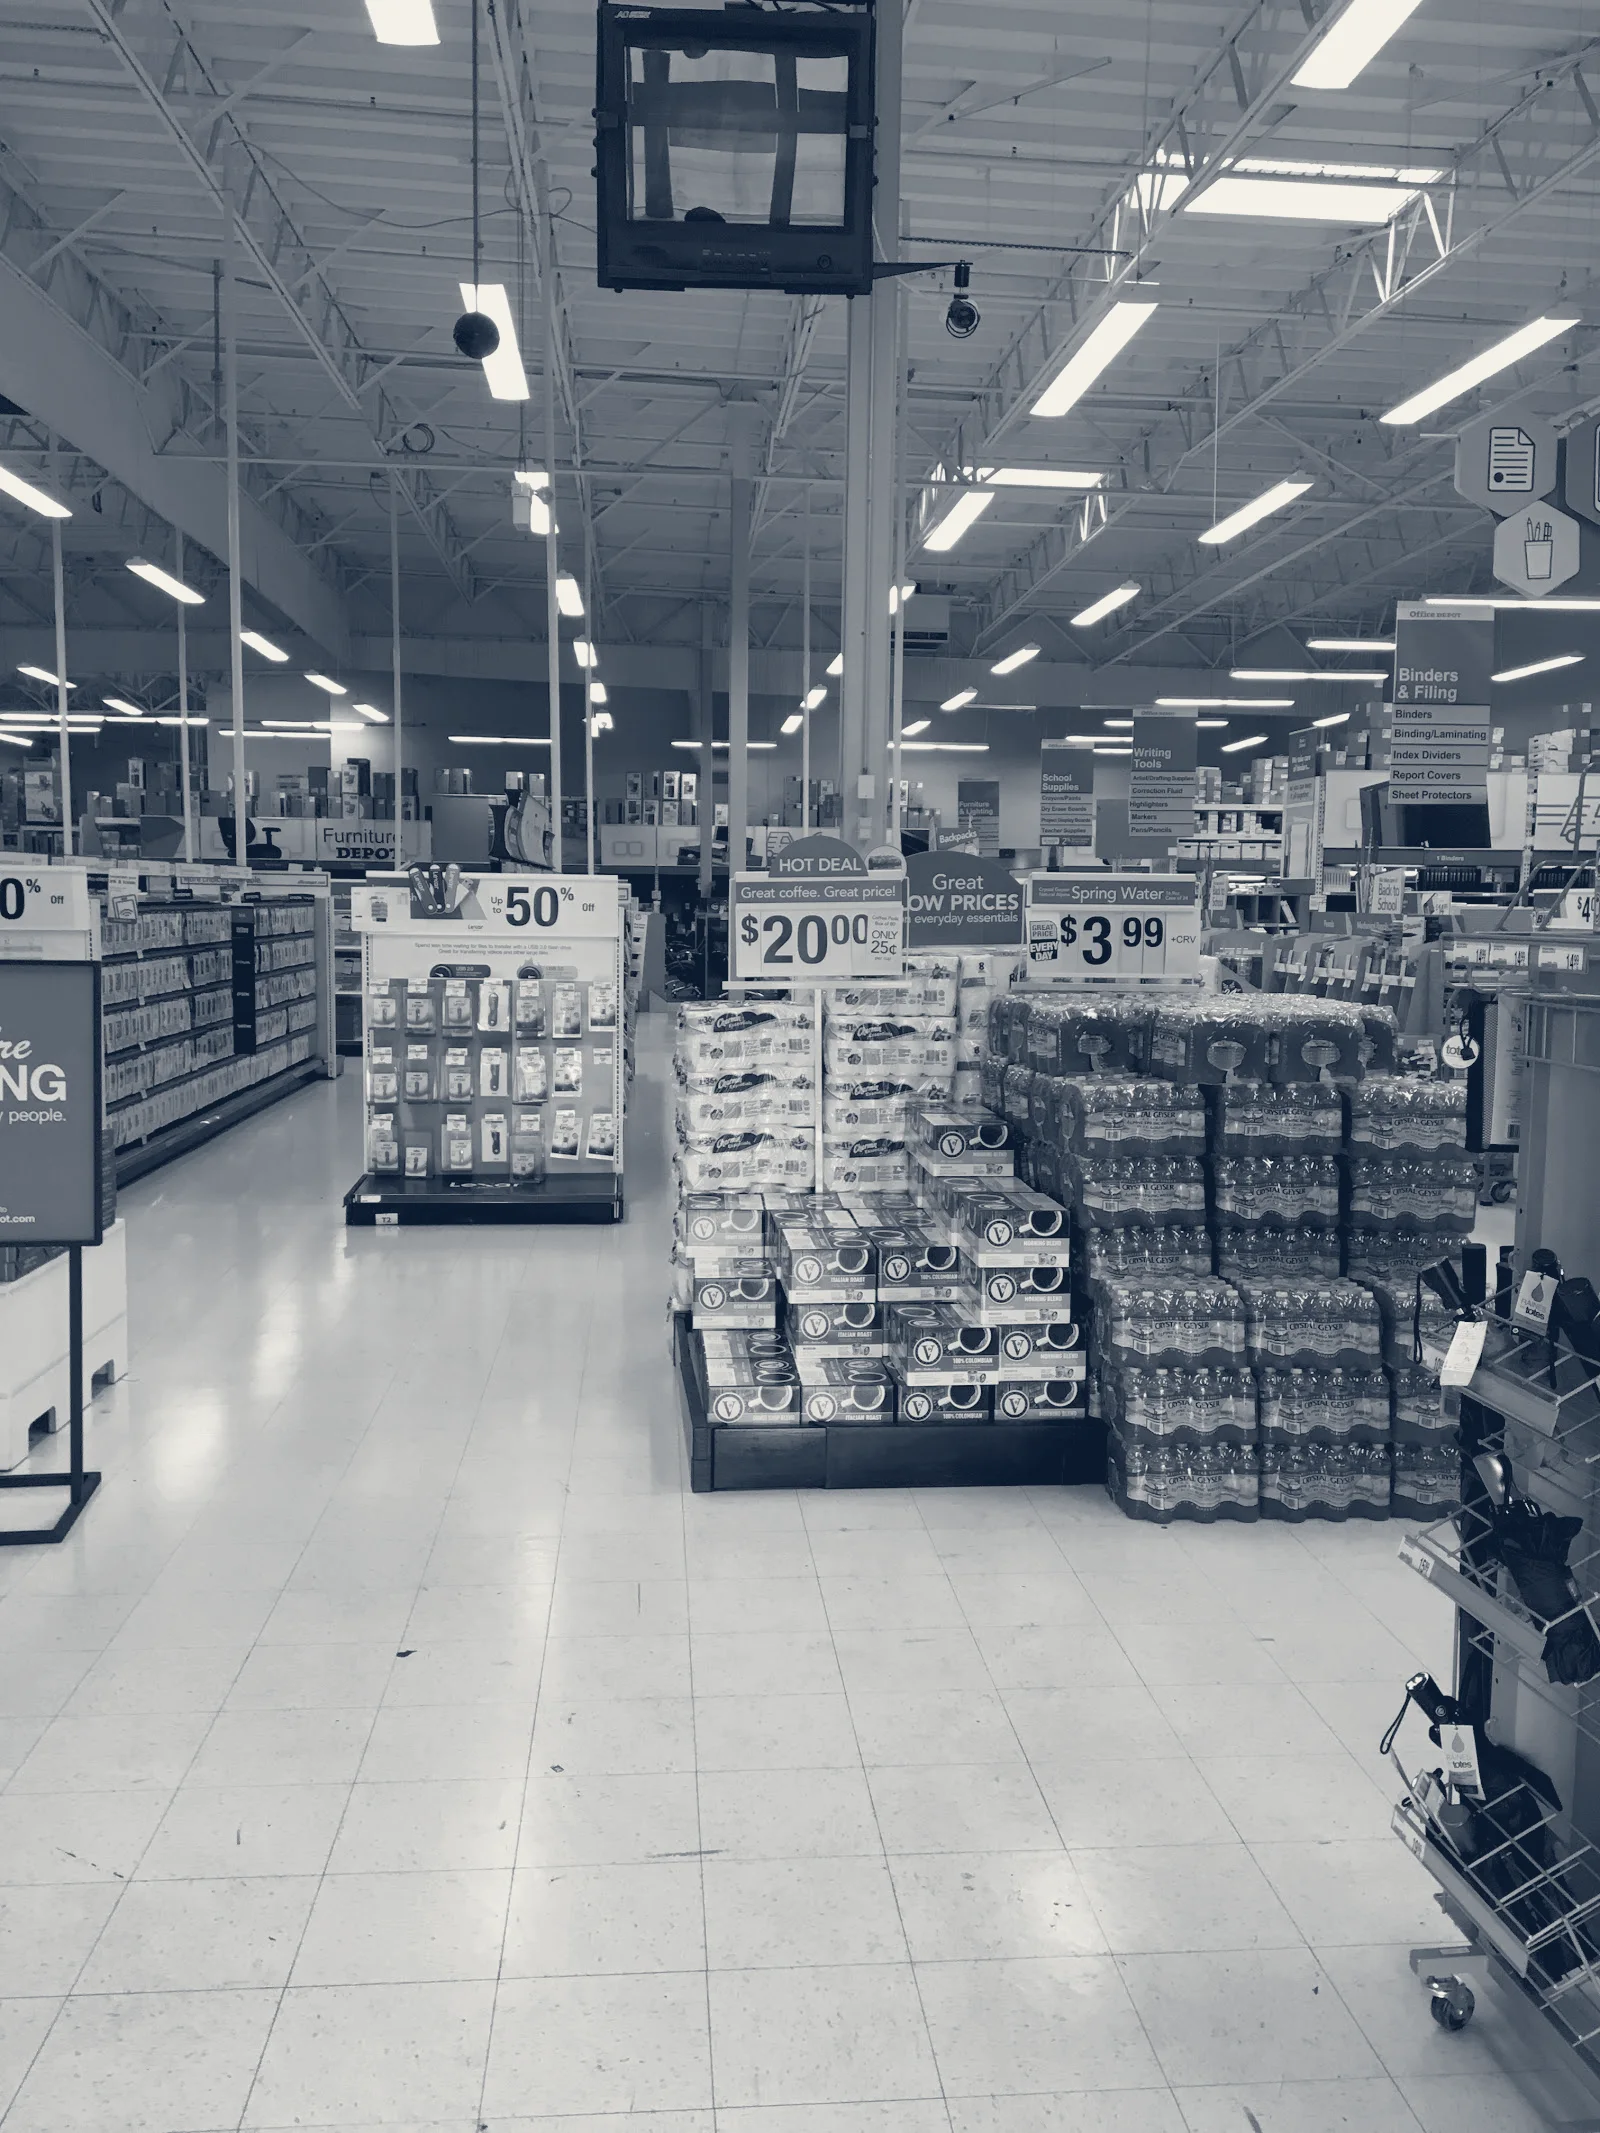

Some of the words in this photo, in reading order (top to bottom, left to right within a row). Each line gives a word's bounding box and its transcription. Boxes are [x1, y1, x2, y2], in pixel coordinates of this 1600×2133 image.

[1400, 668, 1458, 682] Binders
[1398, 685, 1409, 699] &
[1414, 685, 1457, 702] Filing
[1396, 710, 1432, 719] Binders
[1394, 730, 1487, 741] Binding/Laminating
[1134, 748, 1171, 759] Writing
[1394, 751, 1419, 759] Index
[1422, 751, 1461, 760] Dividers
[1134, 759, 1162, 768] Tools
[1042, 774, 1072, 782] School
[1392, 771, 1424, 781] Report
[1427, 772, 1461, 780] Covers
[1042, 783, 1079, 792] Supplies
[1392, 790, 1419, 799] Sheet
[1422, 790, 1472, 800] Protectors
[940, 830, 978, 844] Backpacks
[779, 858, 814, 872] HOT
[818, 858, 862, 872] DEAL
[413, 874, 425, 892] Lexar
[432, 871, 440, 890] Lexar
[932, 874, 984, 890] Great
[741, 887, 775, 899] Great
[779, 886, 820, 898] coffee.
[824, 886, 859, 898] Great
[863, 886, 896, 900] price!
[1072, 886, 1116, 903] Spring
[1121, 886, 1164, 900] Water
[1378, 883, 1392, 896] Back
[1393, 884, 1400, 896] to
[50, 895, 64, 905] Off
[490, 896, 503, 904] Up
[908, 895, 944, 911] OW
[951, 894, 1019, 911] PRICES
[1378, 898, 1398, 911] School
[582, 903, 595, 912] Off
[914, 912, 964, 926] everyday
[967, 911, 1018, 923] essentials
[872, 930, 899, 940] ONLY
[1171, 936, 1197, 944] +CRV
[871, 941, 897, 955] 25¢
[1030, 941, 1059, 952] EVERY
[1036, 951, 1053, 962] DAY
[978, 962, 985, 971] 8
[9, 1108, 67, 1125] people.
[1264, 1108, 1290, 1116] CRYSTAL
[1292, 1108, 1313, 1116] GEYSER
[1129, 1256, 1154, 1264] CRYSTAL
[1526, 1306, 1545, 1320] totes
[1452, 1761, 1472, 1769] totes
